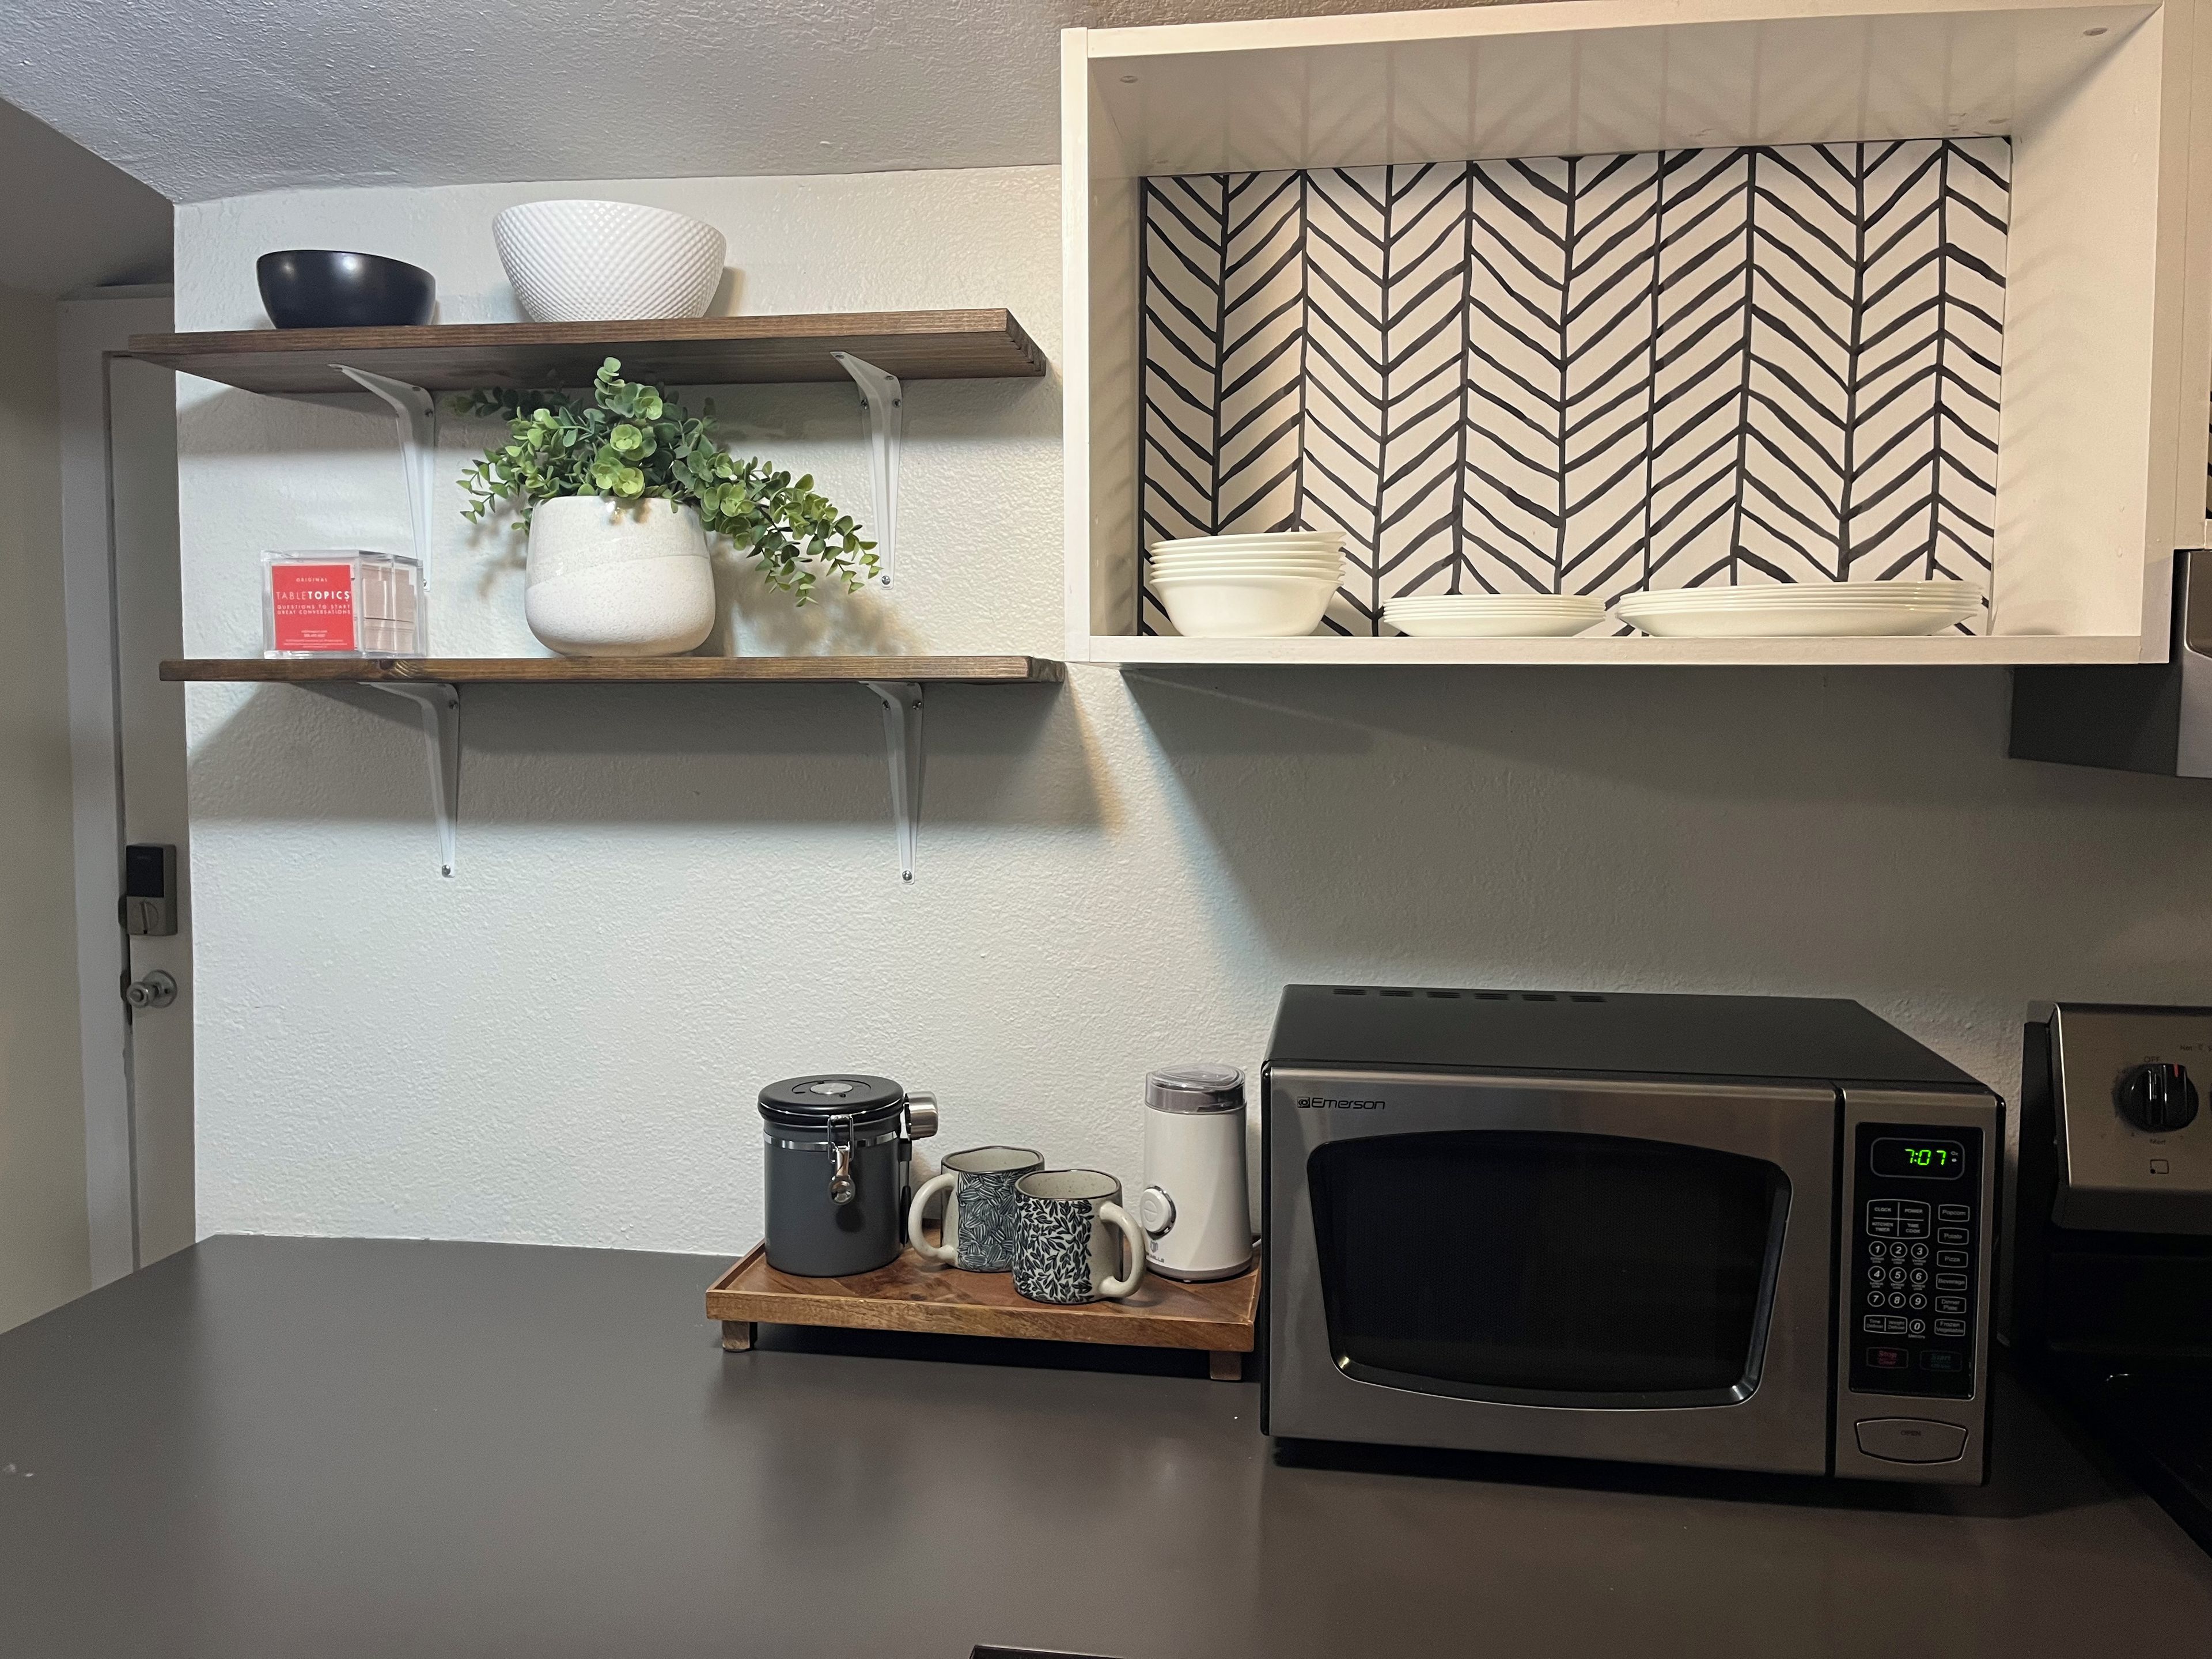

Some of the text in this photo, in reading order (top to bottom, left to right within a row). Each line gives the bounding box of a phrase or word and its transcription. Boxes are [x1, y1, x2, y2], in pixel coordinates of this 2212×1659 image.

[276, 590, 350, 600] TABLETOPICS
[1311, 1097, 1385, 1109] Emerson
[1904, 1149, 1946, 1166] 7:07
[1875, 1245, 1880, 1253] 1
[1895, 1246, 1902, 1254] 2
[1916, 1247, 1923, 1255] 3
[1873, 1270, 1880, 1278] 4
[1894, 1271, 1902, 1279] 5
[1915, 1272, 1922, 1280] 6
[1873, 1295, 1879, 1303] 7
[1893, 1296, 1900, 1304] 8
[1915, 1297, 1922, 1305] 9
